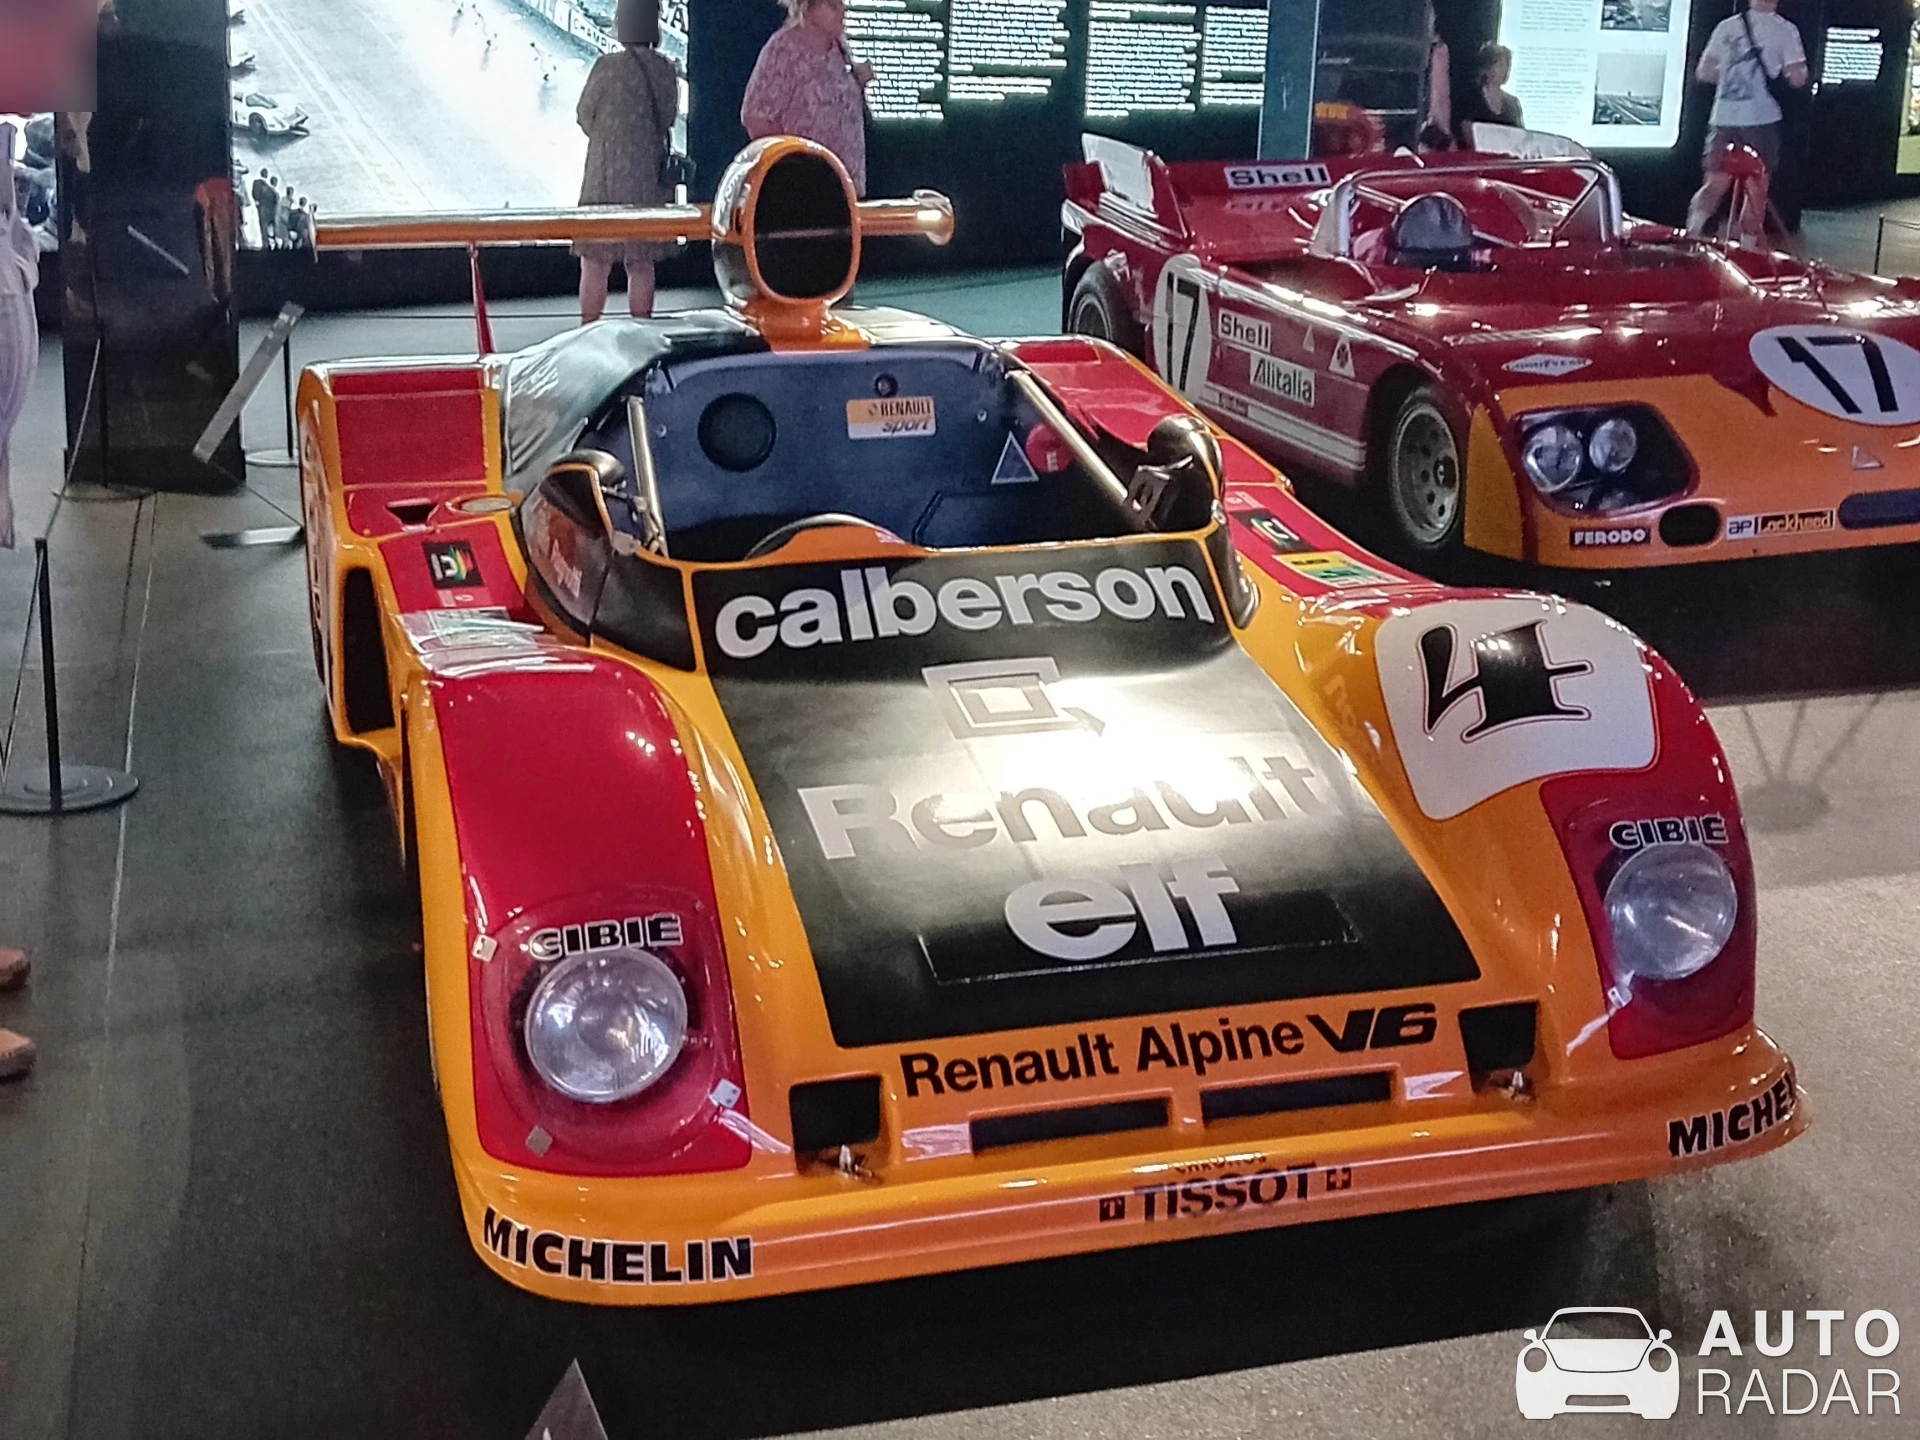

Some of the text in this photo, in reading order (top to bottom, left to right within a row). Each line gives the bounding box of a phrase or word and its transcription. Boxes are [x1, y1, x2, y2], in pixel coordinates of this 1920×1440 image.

[1230, 167, 1328, 186] Shell
[1165, 272, 1200, 392] 17
[1220, 312, 1270, 349] Shell
[880, 400, 931, 417] RENAULT
[1253, 358, 1313, 402] Alitalia
[1776, 334, 1899, 414] 17
[1573, 529, 1647, 545] FERODO
[1757, 510, 1833, 533] Lockheed
[714, 565, 1216, 659] calberson
[1417, 619, 1593, 743] 4
[797, 755, 1342, 860] Renault
[1005, 857, 1240, 961] elf
[900, 1003, 1438, 1097] Renault Alpine V6
[1133, 1160, 1317, 1223] TISSOT
[484, 1204, 753, 1285] MICHELIN
